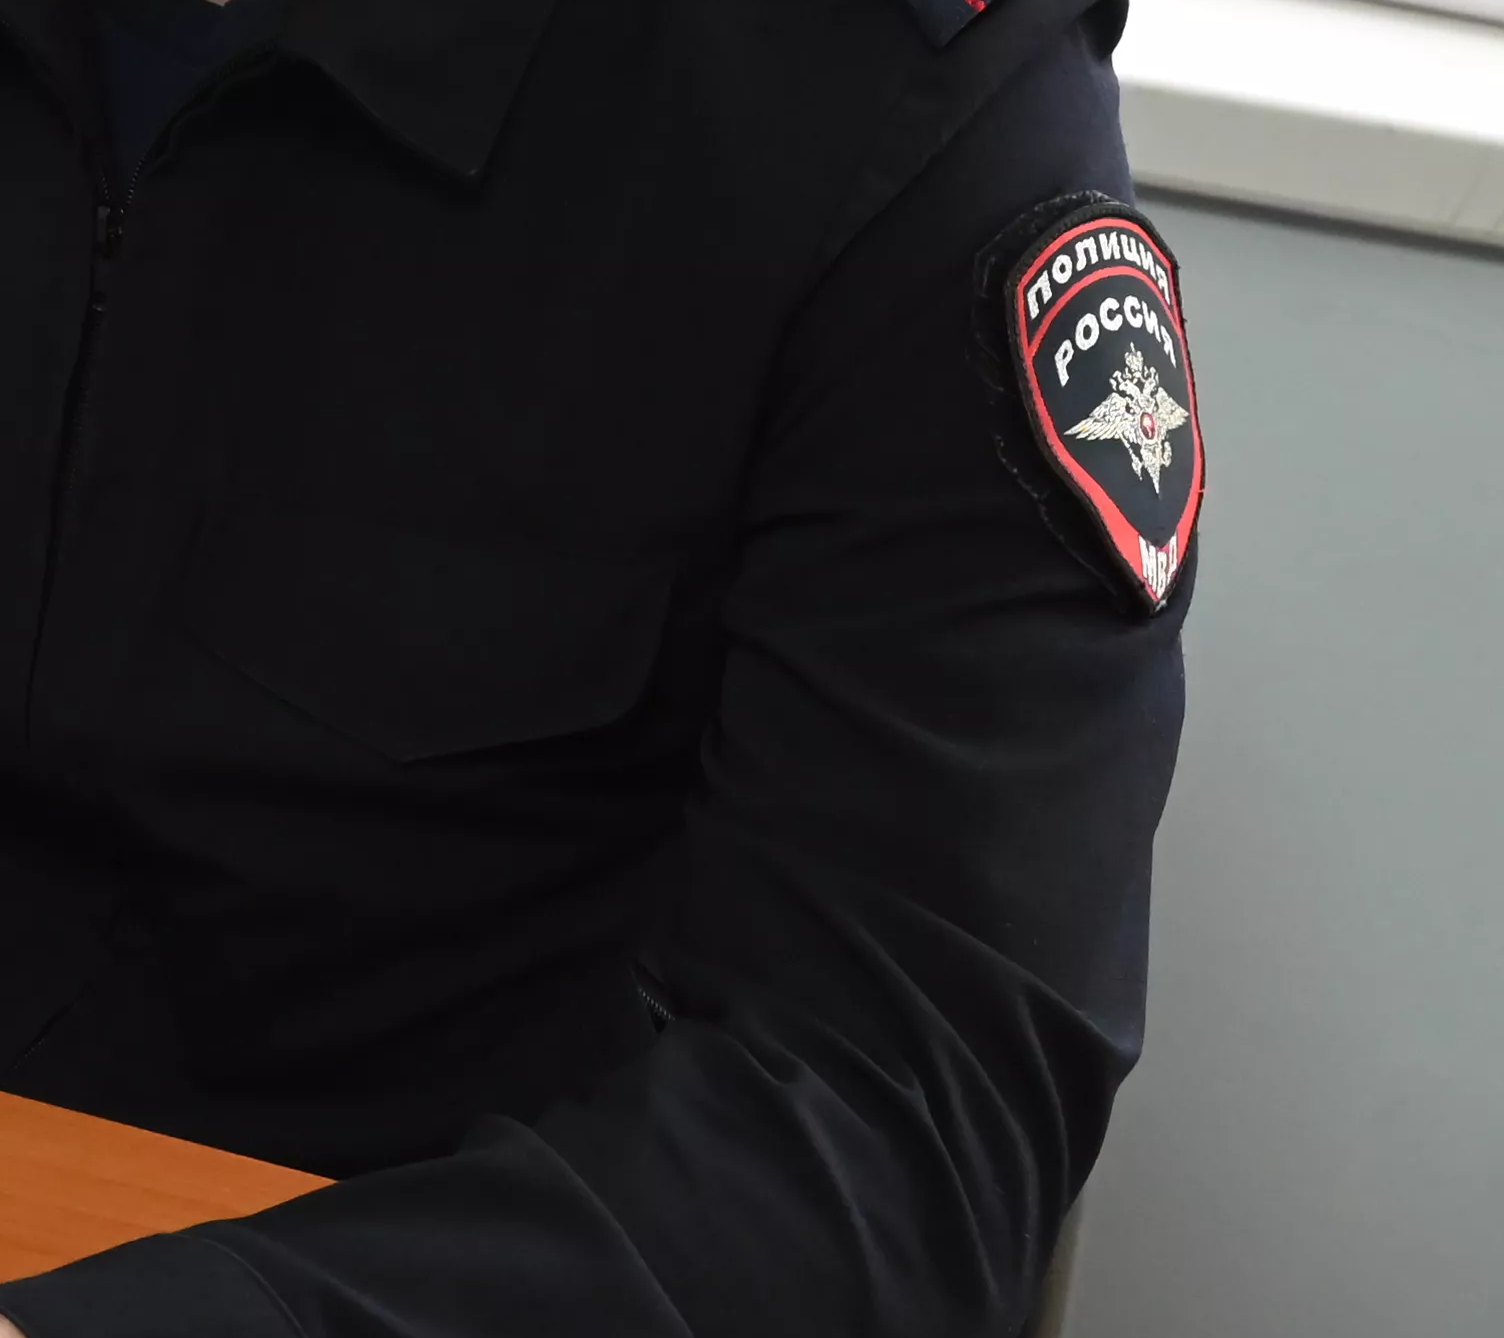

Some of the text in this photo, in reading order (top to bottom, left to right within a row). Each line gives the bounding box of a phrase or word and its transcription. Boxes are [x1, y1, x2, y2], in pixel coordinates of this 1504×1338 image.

[1026, 229, 1174, 321] ПОЛИЦИЯ
[1053, 294, 1178, 388] РОССИЯ
[1138, 533, 1179, 601] МВД
